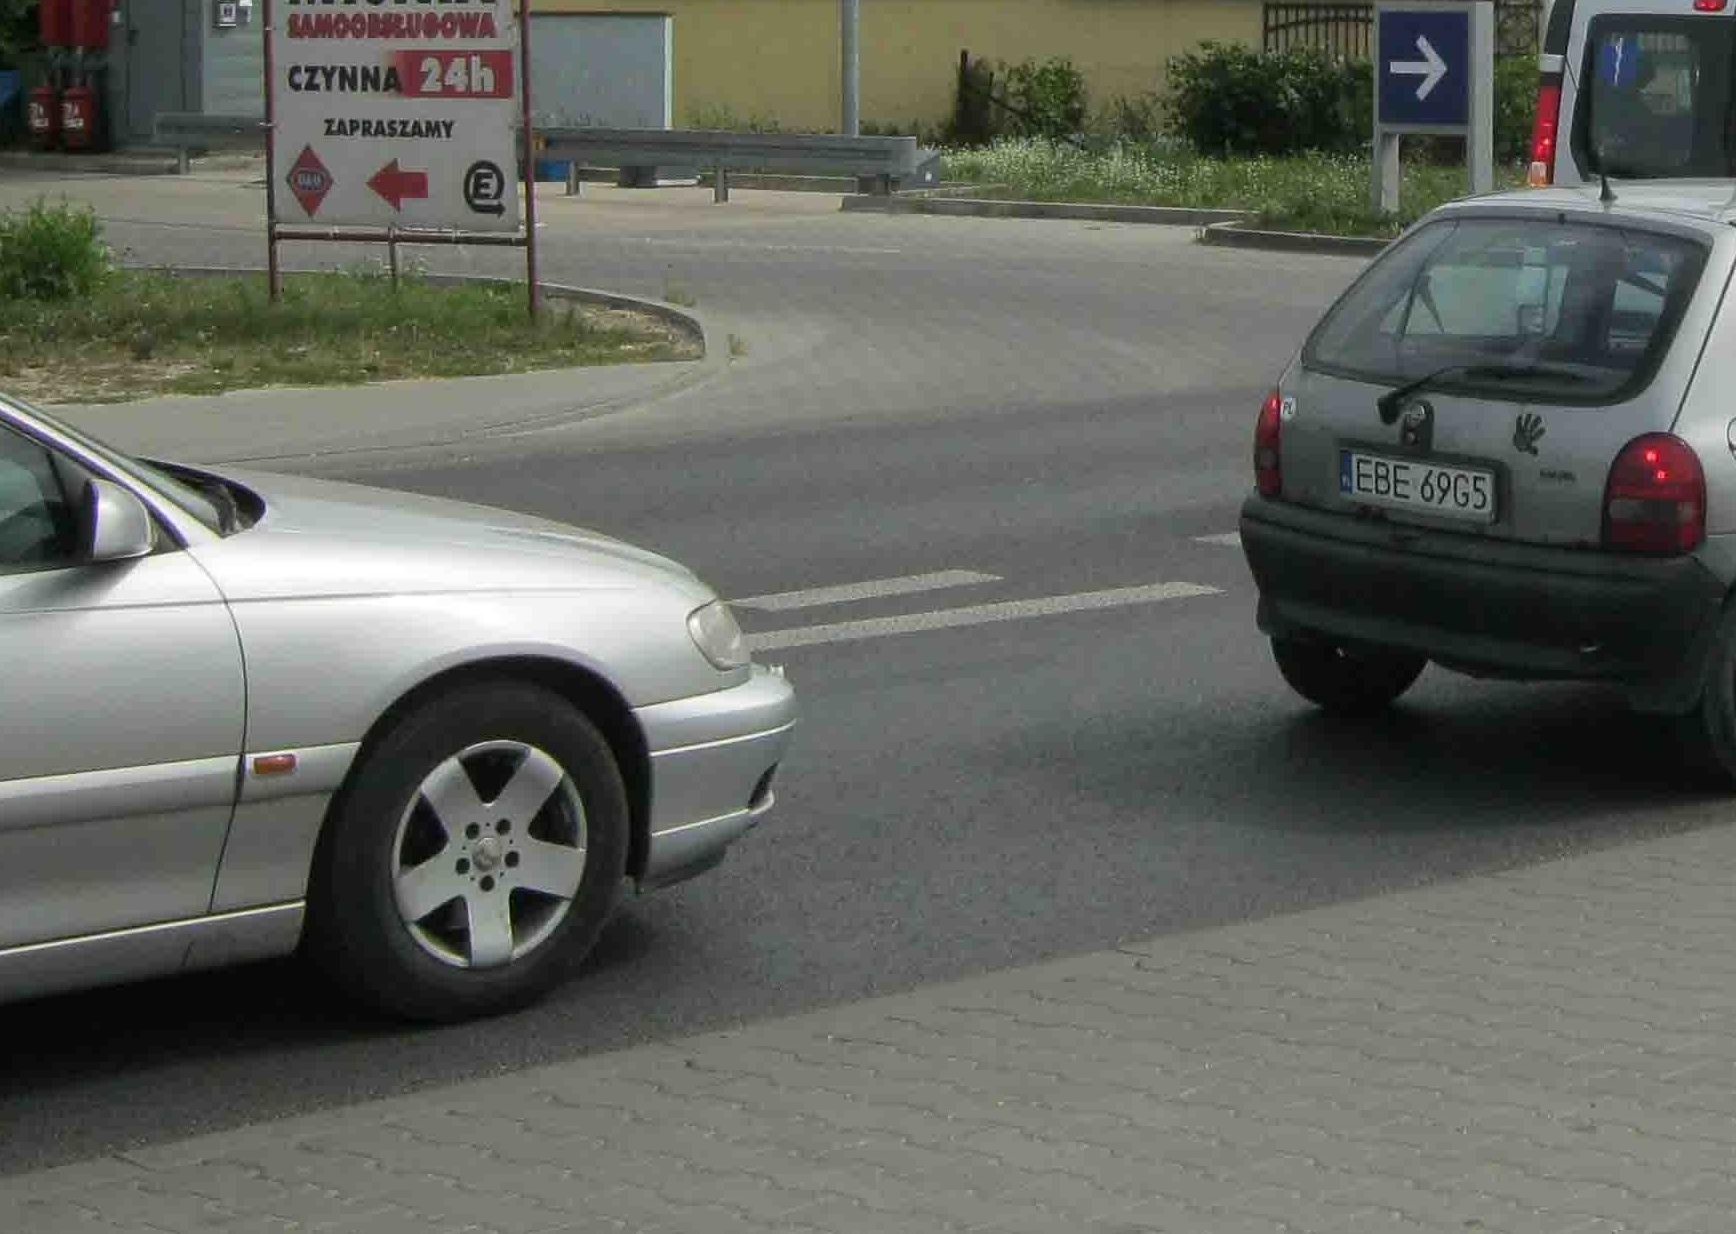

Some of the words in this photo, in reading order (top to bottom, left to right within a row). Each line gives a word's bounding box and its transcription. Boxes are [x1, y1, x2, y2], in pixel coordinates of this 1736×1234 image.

[289, 65, 402, 93] CZYNNA
[419, 53, 496, 93] 24h
[324, 119, 456, 139] ZAPRASZAMY
[1356, 457, 1411, 500] EBE
[1420, 469, 1488, 511] 69G5
